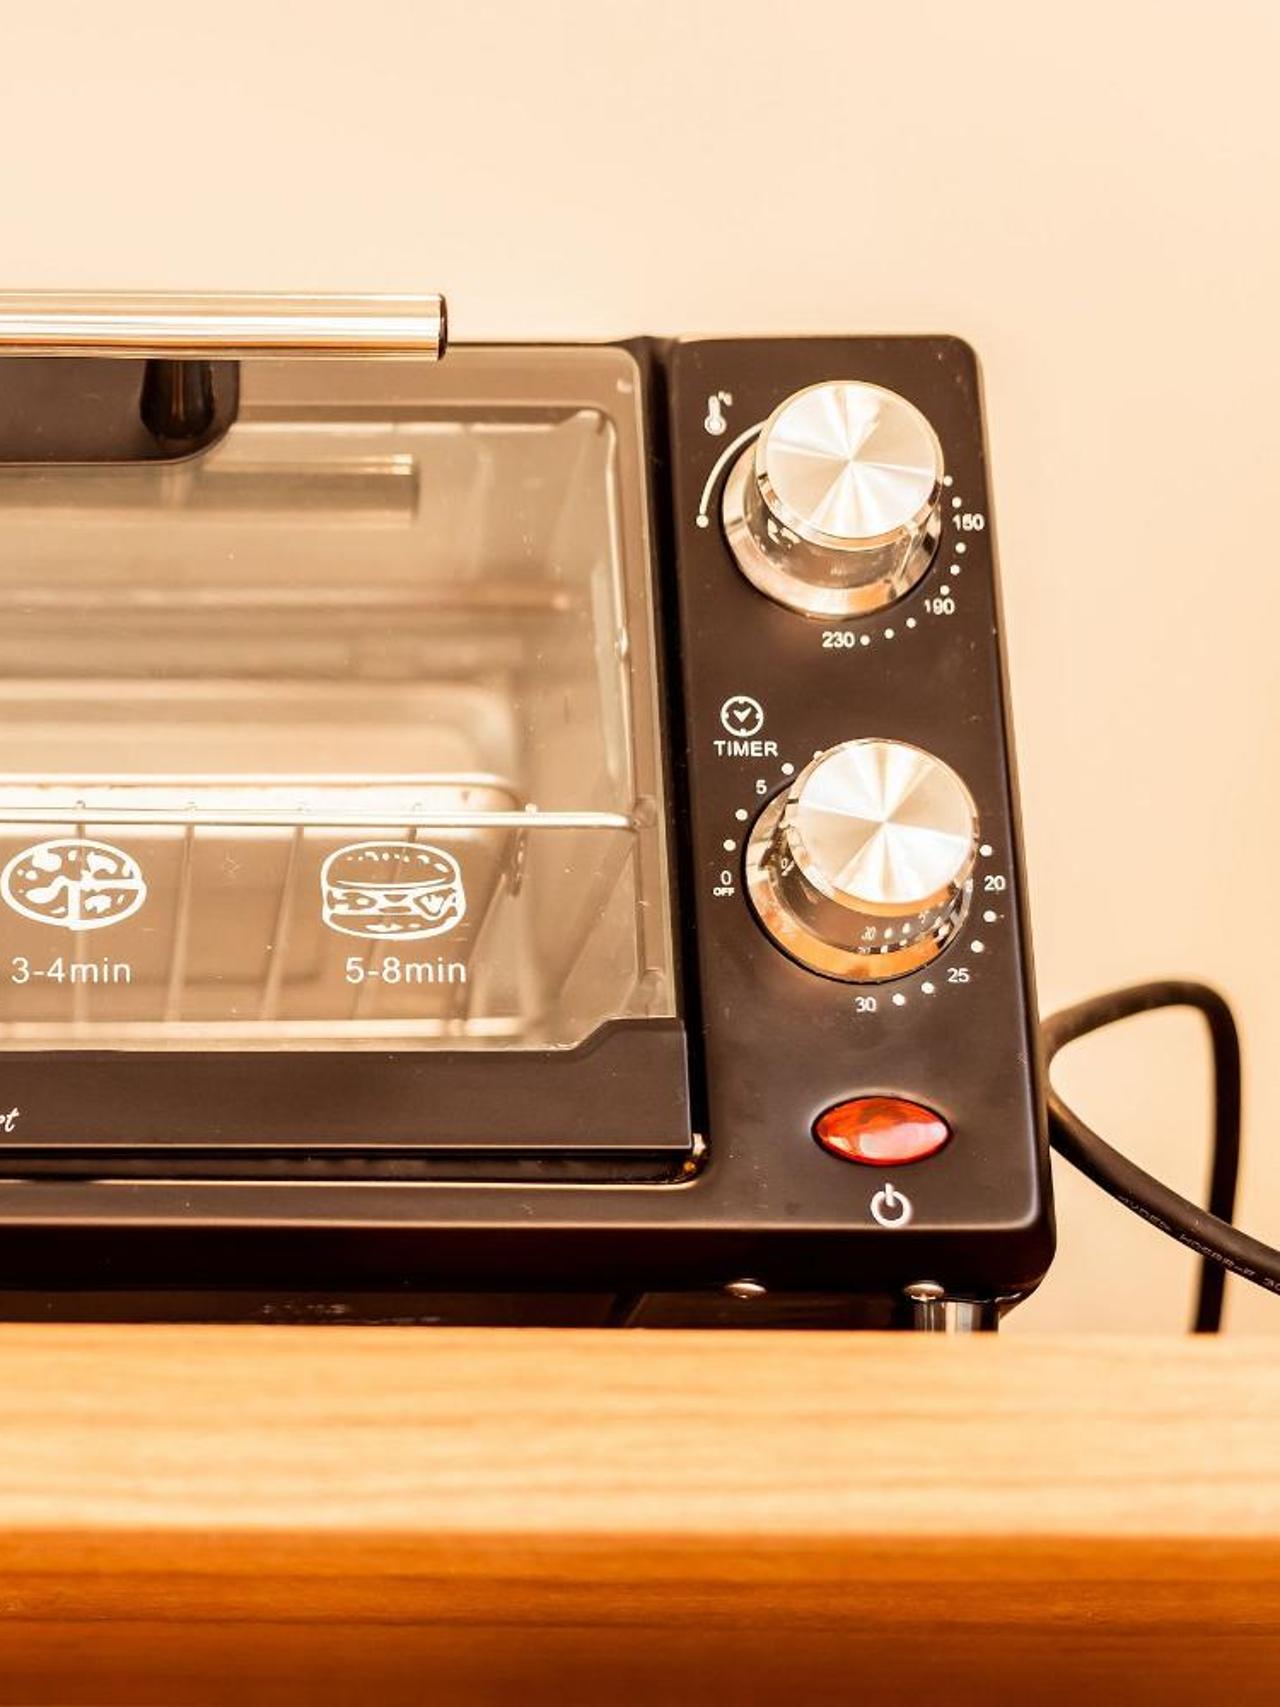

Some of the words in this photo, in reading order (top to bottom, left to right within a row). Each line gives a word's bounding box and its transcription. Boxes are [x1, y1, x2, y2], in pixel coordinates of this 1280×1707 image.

[952, 513, 985, 531] 150
[924, 598, 955, 616] 190
[822, 631, 855, 648] 230
[713, 741, 778, 757] TIMER
[755, 780, 767, 795] 5
[721, 870, 732, 886] 0
[984, 876, 1006, 891] 20
[713, 887, 735, 897] OFF
[11, 957, 131, 984] 3-4min
[345, 957, 466, 984] 5-8min
[947, 967, 970, 984] 25
[854, 996, 878, 1013] 30
